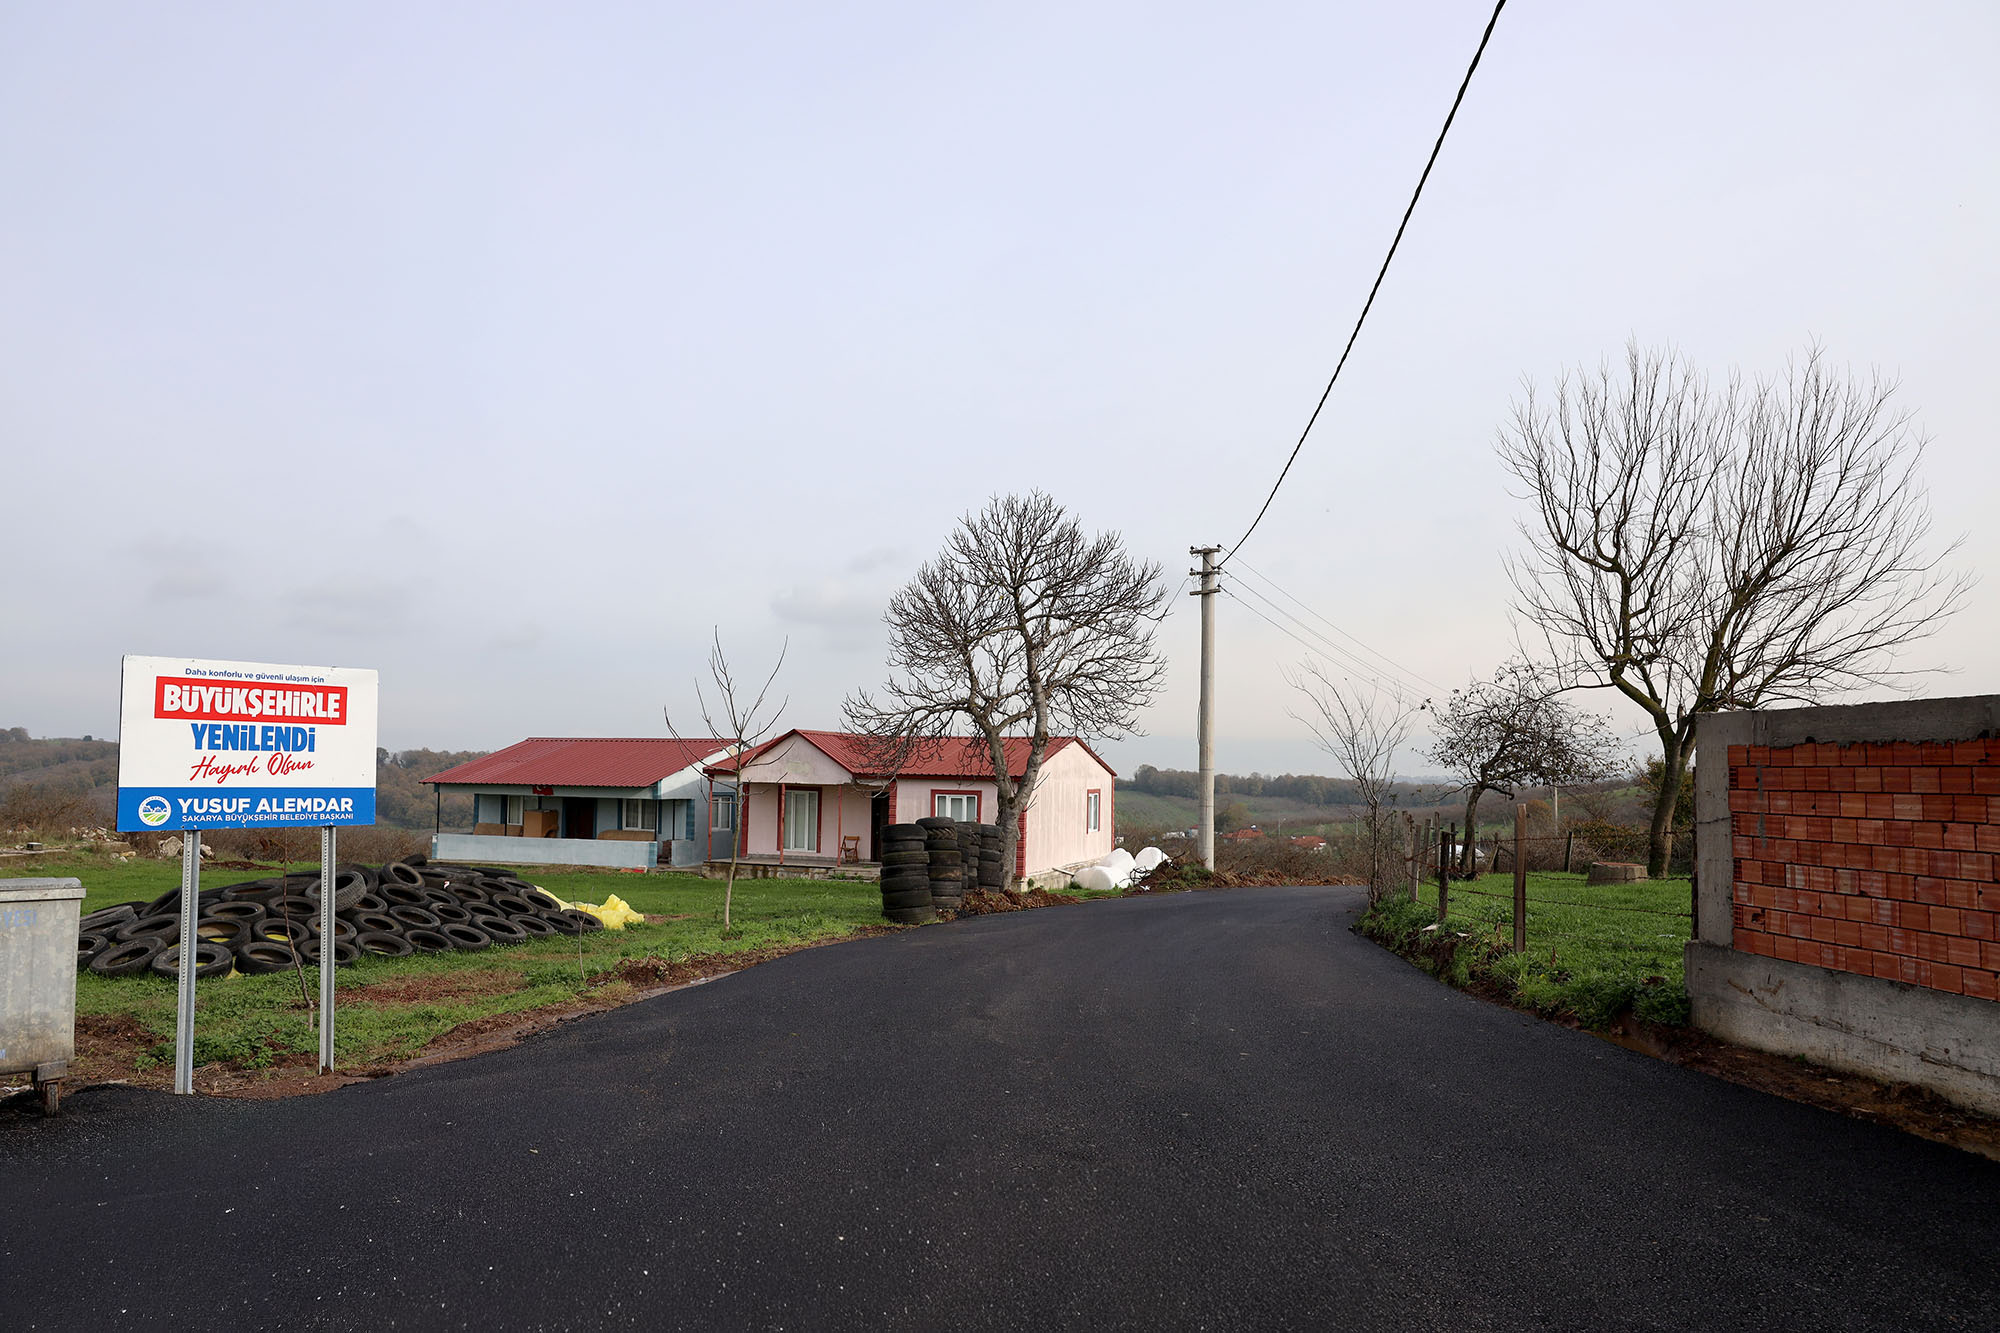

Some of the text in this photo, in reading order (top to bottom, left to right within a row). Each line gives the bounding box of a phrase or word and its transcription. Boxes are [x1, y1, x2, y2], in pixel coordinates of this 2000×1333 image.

[185, 668, 207, 676] Daha
[208, 669, 243, 679] konforlu
[255, 672, 284, 681] güvenli
[285, 674, 310, 682] ulaşım
[163, 684, 341, 718] BÜYÜKŞEHİRLE
[191, 723, 316, 752] YENİLENDİ
[189, 752, 315, 784] Hayırlı Olsun
[177, 798, 251, 814] YUSUF
[255, 797, 354, 813] ALEMDAR
[225, 813, 278, 822] BÜYÜKŞEHİR
[279, 813, 318, 821] BELEDİYE
[319, 813, 354, 821] BAŞKANI
